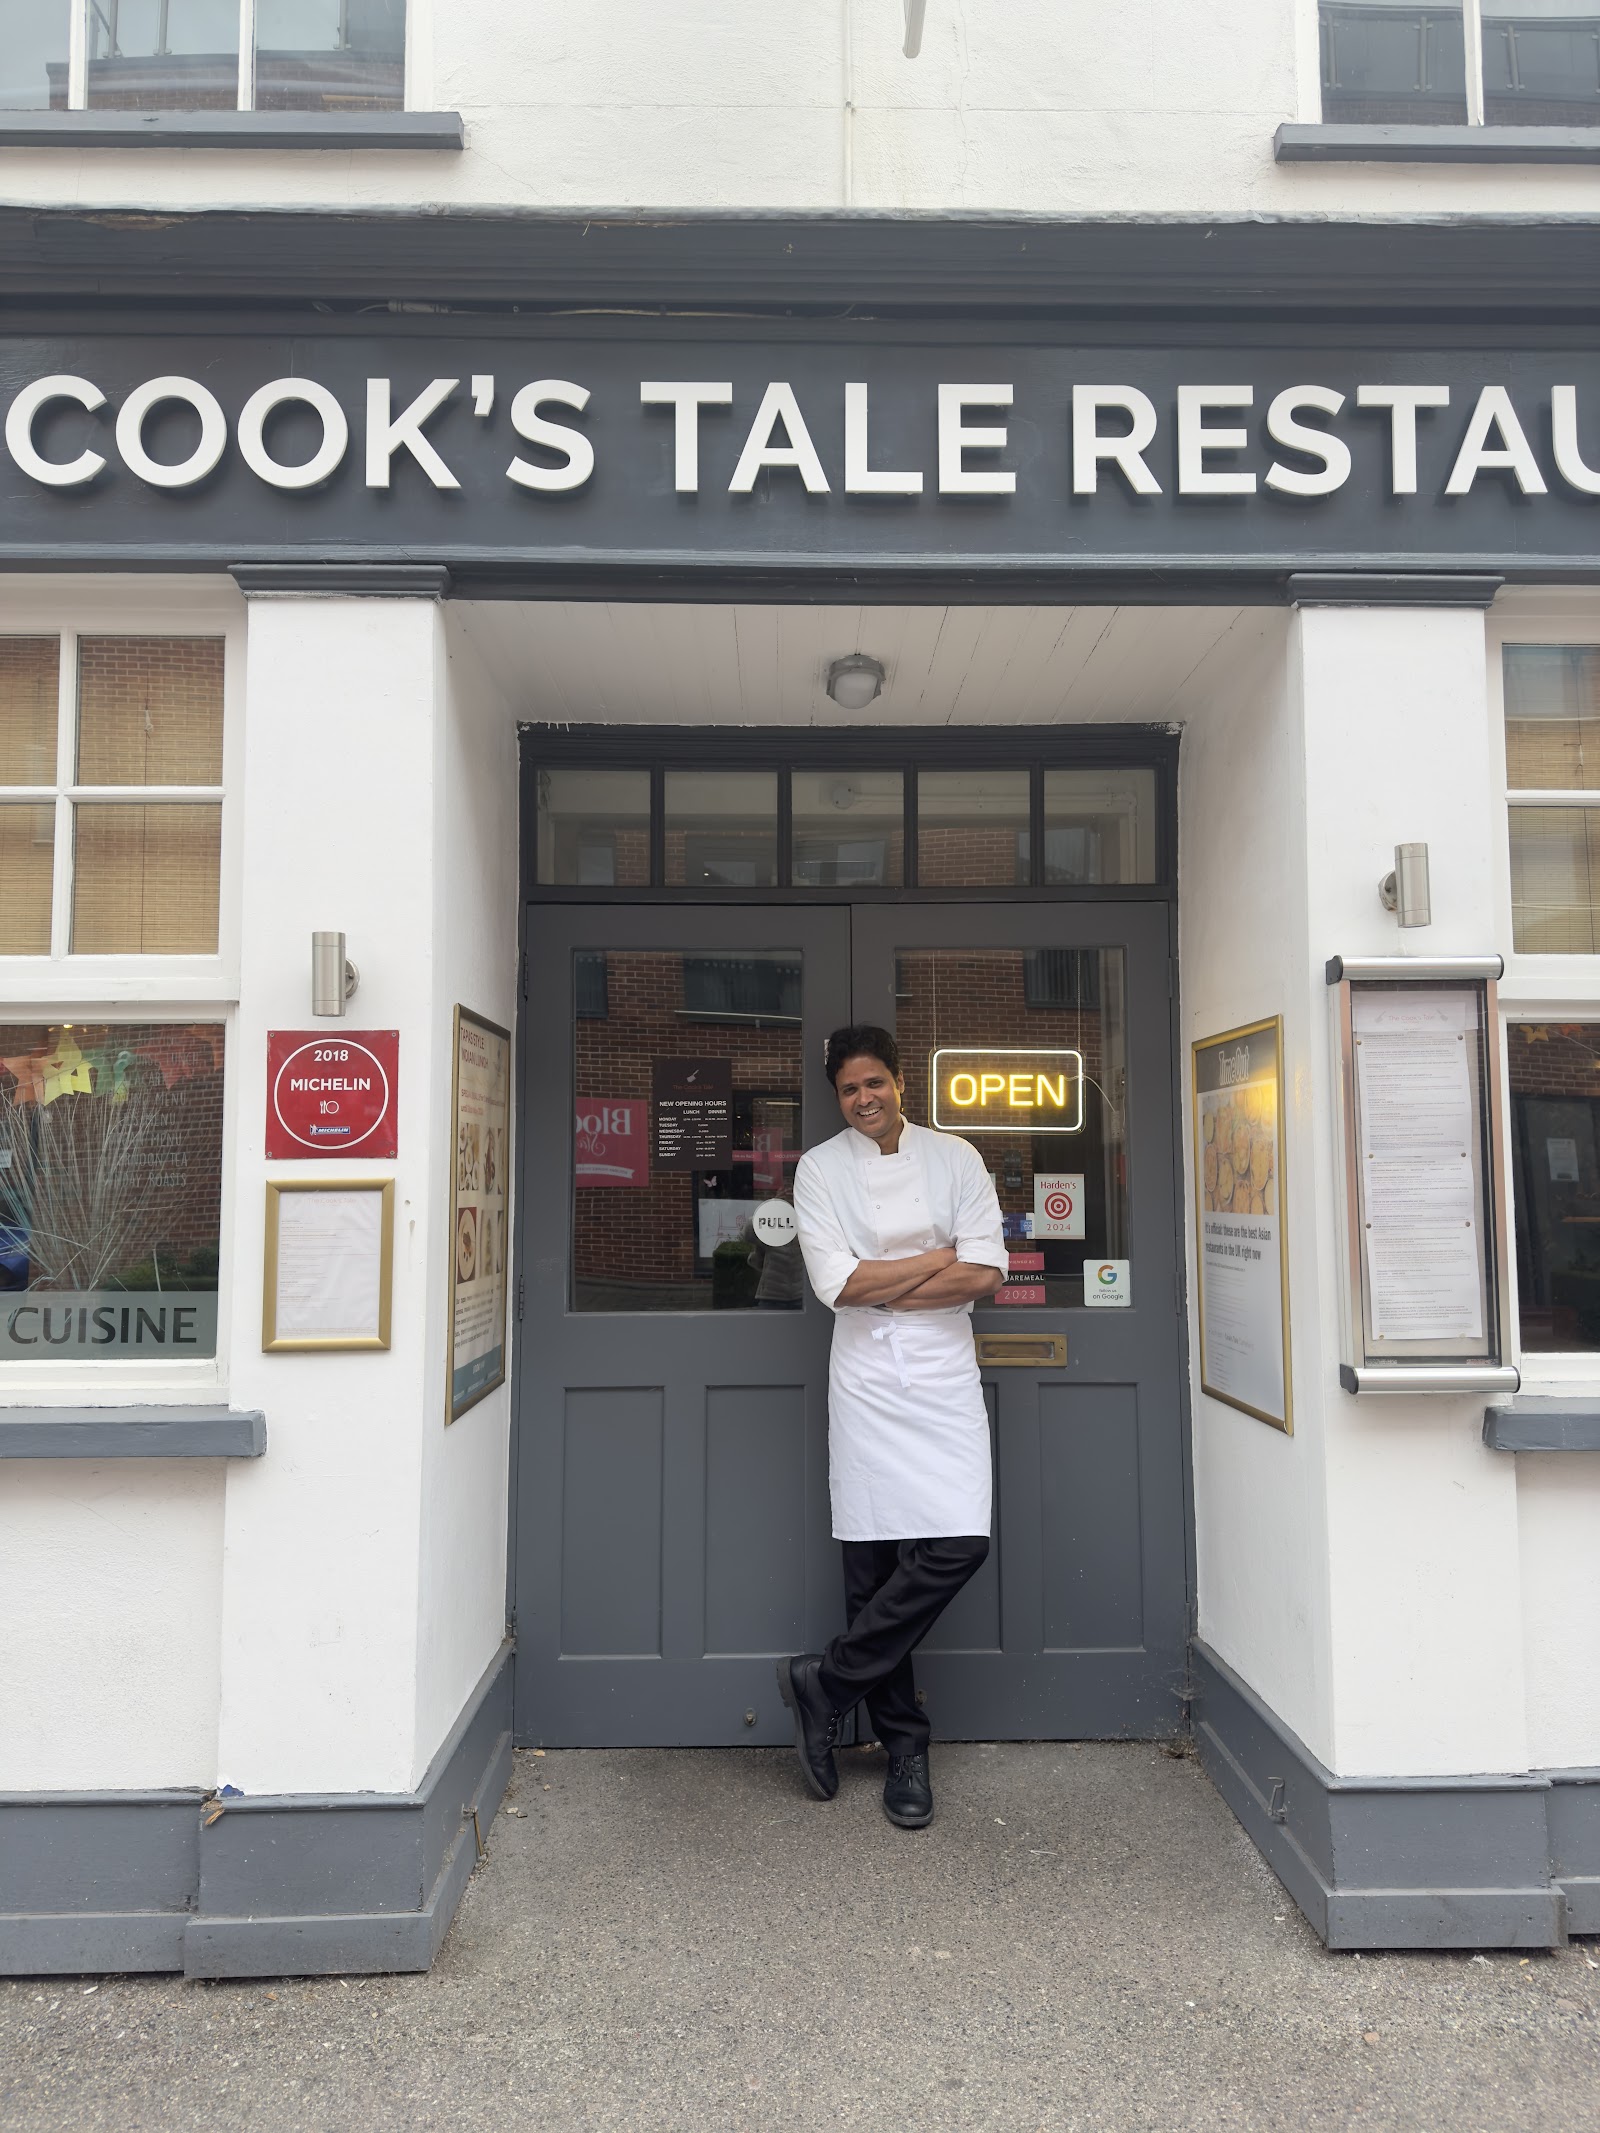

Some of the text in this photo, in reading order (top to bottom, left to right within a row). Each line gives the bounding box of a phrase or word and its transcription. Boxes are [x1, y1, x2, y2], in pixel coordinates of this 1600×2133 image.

[5, 374, 595, 492] COOK'S
[640, 381, 1016, 495] TALE
[314, 1050, 349, 1062] 2018
[290, 1078, 371, 1091] MICHELIN
[950, 1073, 1066, 1107] OPEN
[1040, 1181, 1077, 1190] Harden's
[758, 1217, 795, 1230] PULL
[1046, 1223, 1071, 1232] 2024
[1248, 1226, 1258, 1240] best
[1258, 1226, 1272, 1241] Asian
[1241, 1245, 1252, 1261] right
[1004, 1290, 1036, 1300] 2023
[1102, 1293, 1124, 1301] Google
[7, 1307, 197, 1345] CUISINE
